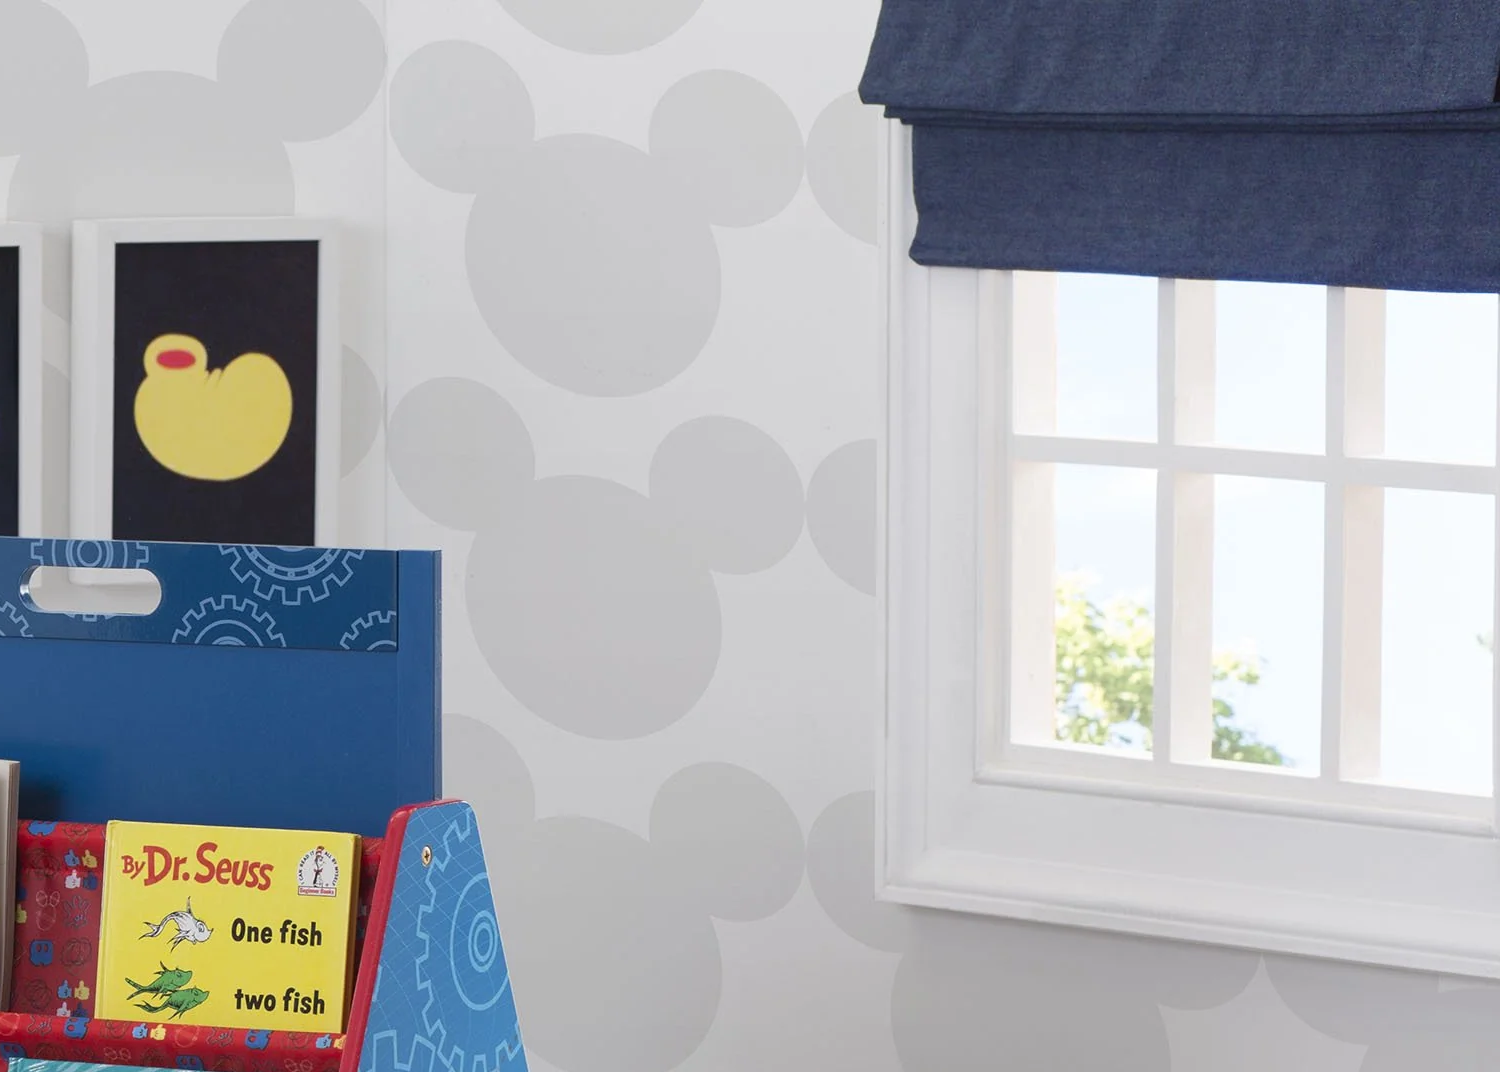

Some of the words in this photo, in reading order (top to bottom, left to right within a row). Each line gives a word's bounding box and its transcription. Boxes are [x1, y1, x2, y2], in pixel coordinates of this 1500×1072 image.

[121, 855, 145, 879] By
[143, 845, 190, 886] Dr.
[194, 841, 274, 891] Seuss
[231, 918, 272, 943] One
[280, 919, 322, 946] fish
[234, 989, 276, 1011] two
[283, 987, 325, 1015] fish
